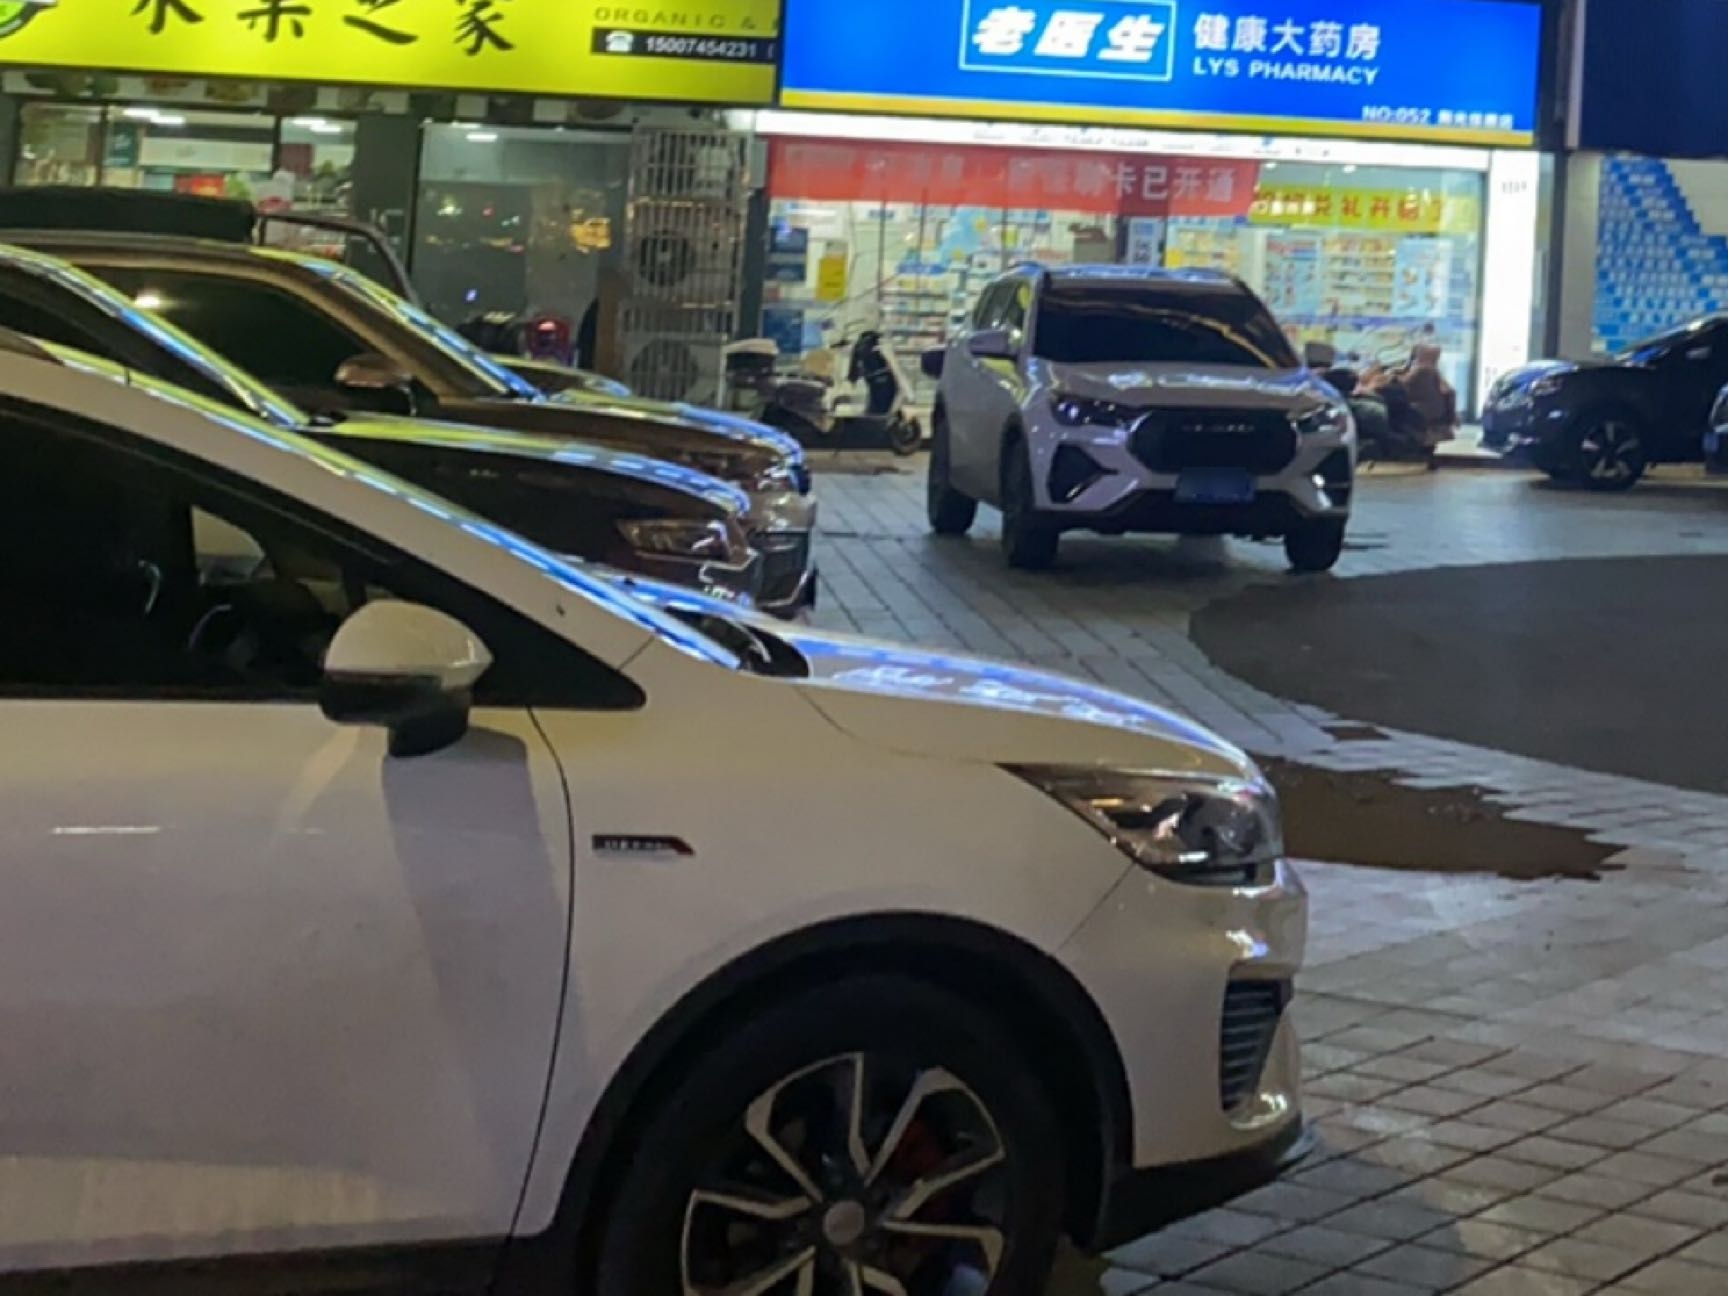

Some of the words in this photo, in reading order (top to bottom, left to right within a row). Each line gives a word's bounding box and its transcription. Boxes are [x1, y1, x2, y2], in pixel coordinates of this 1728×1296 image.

[594, 6, 726, 30] ORGANIC
[973, 7, 1165, 63] 老医生
[1193, 12, 1382, 61] 健康大药房
[1193, 57, 1240, 78] LYS
[1250, 59, 1379, 87] PHARMACY
